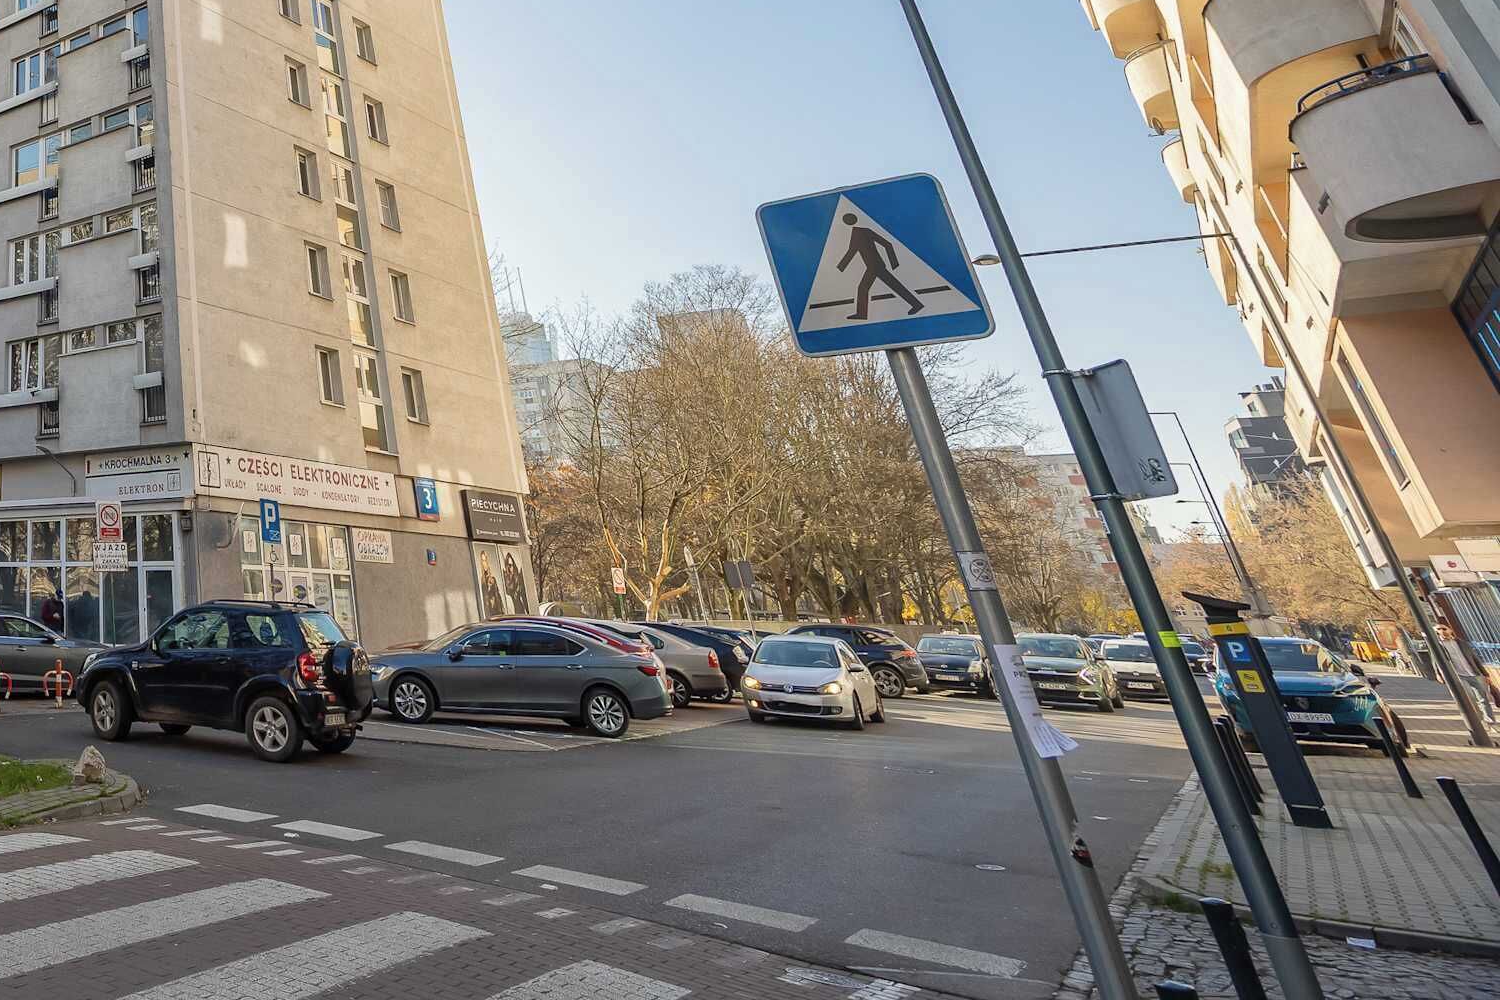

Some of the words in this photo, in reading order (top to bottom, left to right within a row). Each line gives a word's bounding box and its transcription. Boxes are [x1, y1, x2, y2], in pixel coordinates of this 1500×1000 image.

[104, 456, 162, 469] KROCHMALNA
[165, 454, 171, 464] 3
[238, 457, 283, 478] CZĘŚCI
[290, 464, 380, 490] ELEKTRONICZNE
[118, 483, 164, 496] ELEKTRON
[423, 488, 433, 509] 3
[471, 498, 516, 513] PIECYCHNA
[264, 503, 276, 529] P
